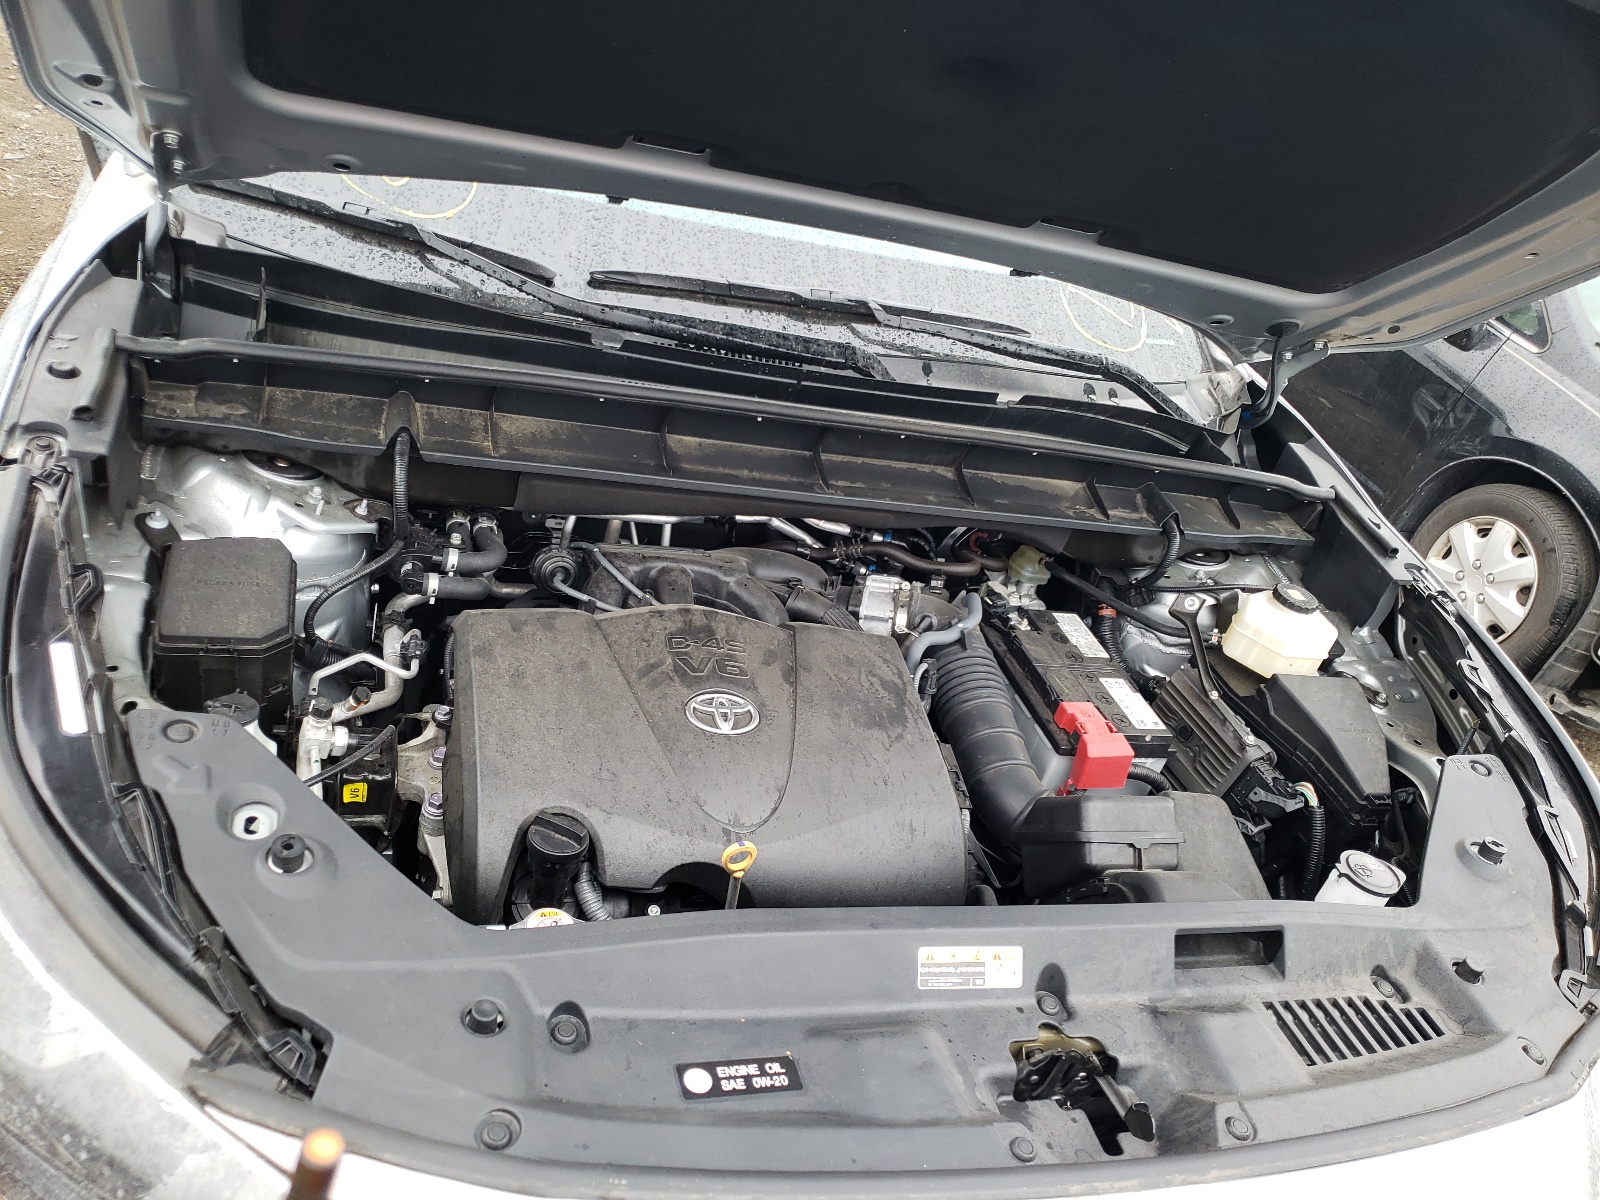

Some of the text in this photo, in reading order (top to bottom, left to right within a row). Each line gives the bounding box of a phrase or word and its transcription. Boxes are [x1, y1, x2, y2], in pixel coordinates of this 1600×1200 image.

[665, 635, 747, 655] D-4S
[674, 655, 751, 679] V6
[350, 787, 360, 799] V6
[716, 1062, 786, 1078] ENGINE OIL
[720, 1075, 789, 1091] SAE 0W-20
